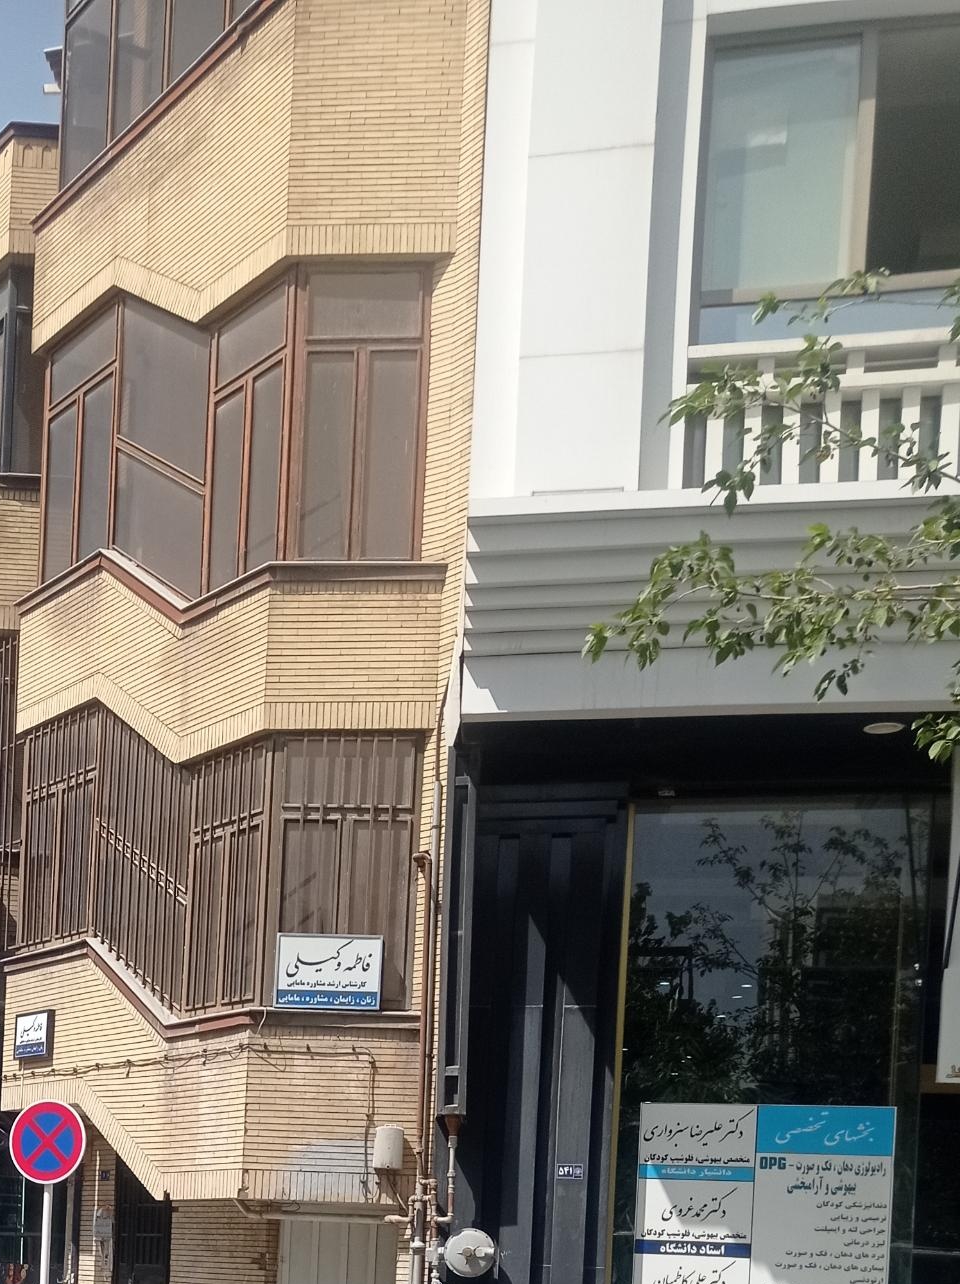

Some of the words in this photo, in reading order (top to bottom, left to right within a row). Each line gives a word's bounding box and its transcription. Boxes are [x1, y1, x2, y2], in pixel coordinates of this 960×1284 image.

[285, 939, 355, 978] وکیلی
[343, 952, 373, 972] فاطمه
[306, 980, 326, 988] مشاوره
[327, 980, 341, 989] ارشد
[341, 980, 367, 989] کارشناس
[719, 1108, 755, 1143] دکتر
[775, 1111, 829, 1144] تخصصی
[643, 1122, 689, 1147] سبزواری
[689, 1121, 723, 1146] علیرضا
[643, 1153, 669, 1163] کودکان
[759, 1156, 787, 1170] OPG
[558, 1166, 572, 1175] ۵۴۱
[661, 1166, 697, 1175] دانشگاه
[796, 1163, 815, 1174] صورت
[821, 1160, 832, 1172] فک
[698, 1167, 732, 1177] دانشیار
[825, 1182, 829, 1195] و
[830, 1180, 857, 1196] بیهوشی
[701, 1187, 738, 1221] دکتر
[815, 1200, 844, 1209] کودکان
[844, 1201, 887, 1210] دندانپزشکی
[691, 1203, 708, 1218] محمد
[861, 1215, 887, 1223] ترمیمی
[640, 1228, 666, 1238] کودکان
[719, 1232, 747, 1240] متخصص
[859, 1227, 886, 1235] جراحی
[659, 1243, 697, 1254] دانشگاه
[699, 1244, 726, 1255] استاد
[785, 1249, 808, 1257] صورت
[774, 1262, 797, 1270] صورت
[860, 1264, 884, 1272] بیماری
[849, 1277, 884, 1284] ارتودنسی
